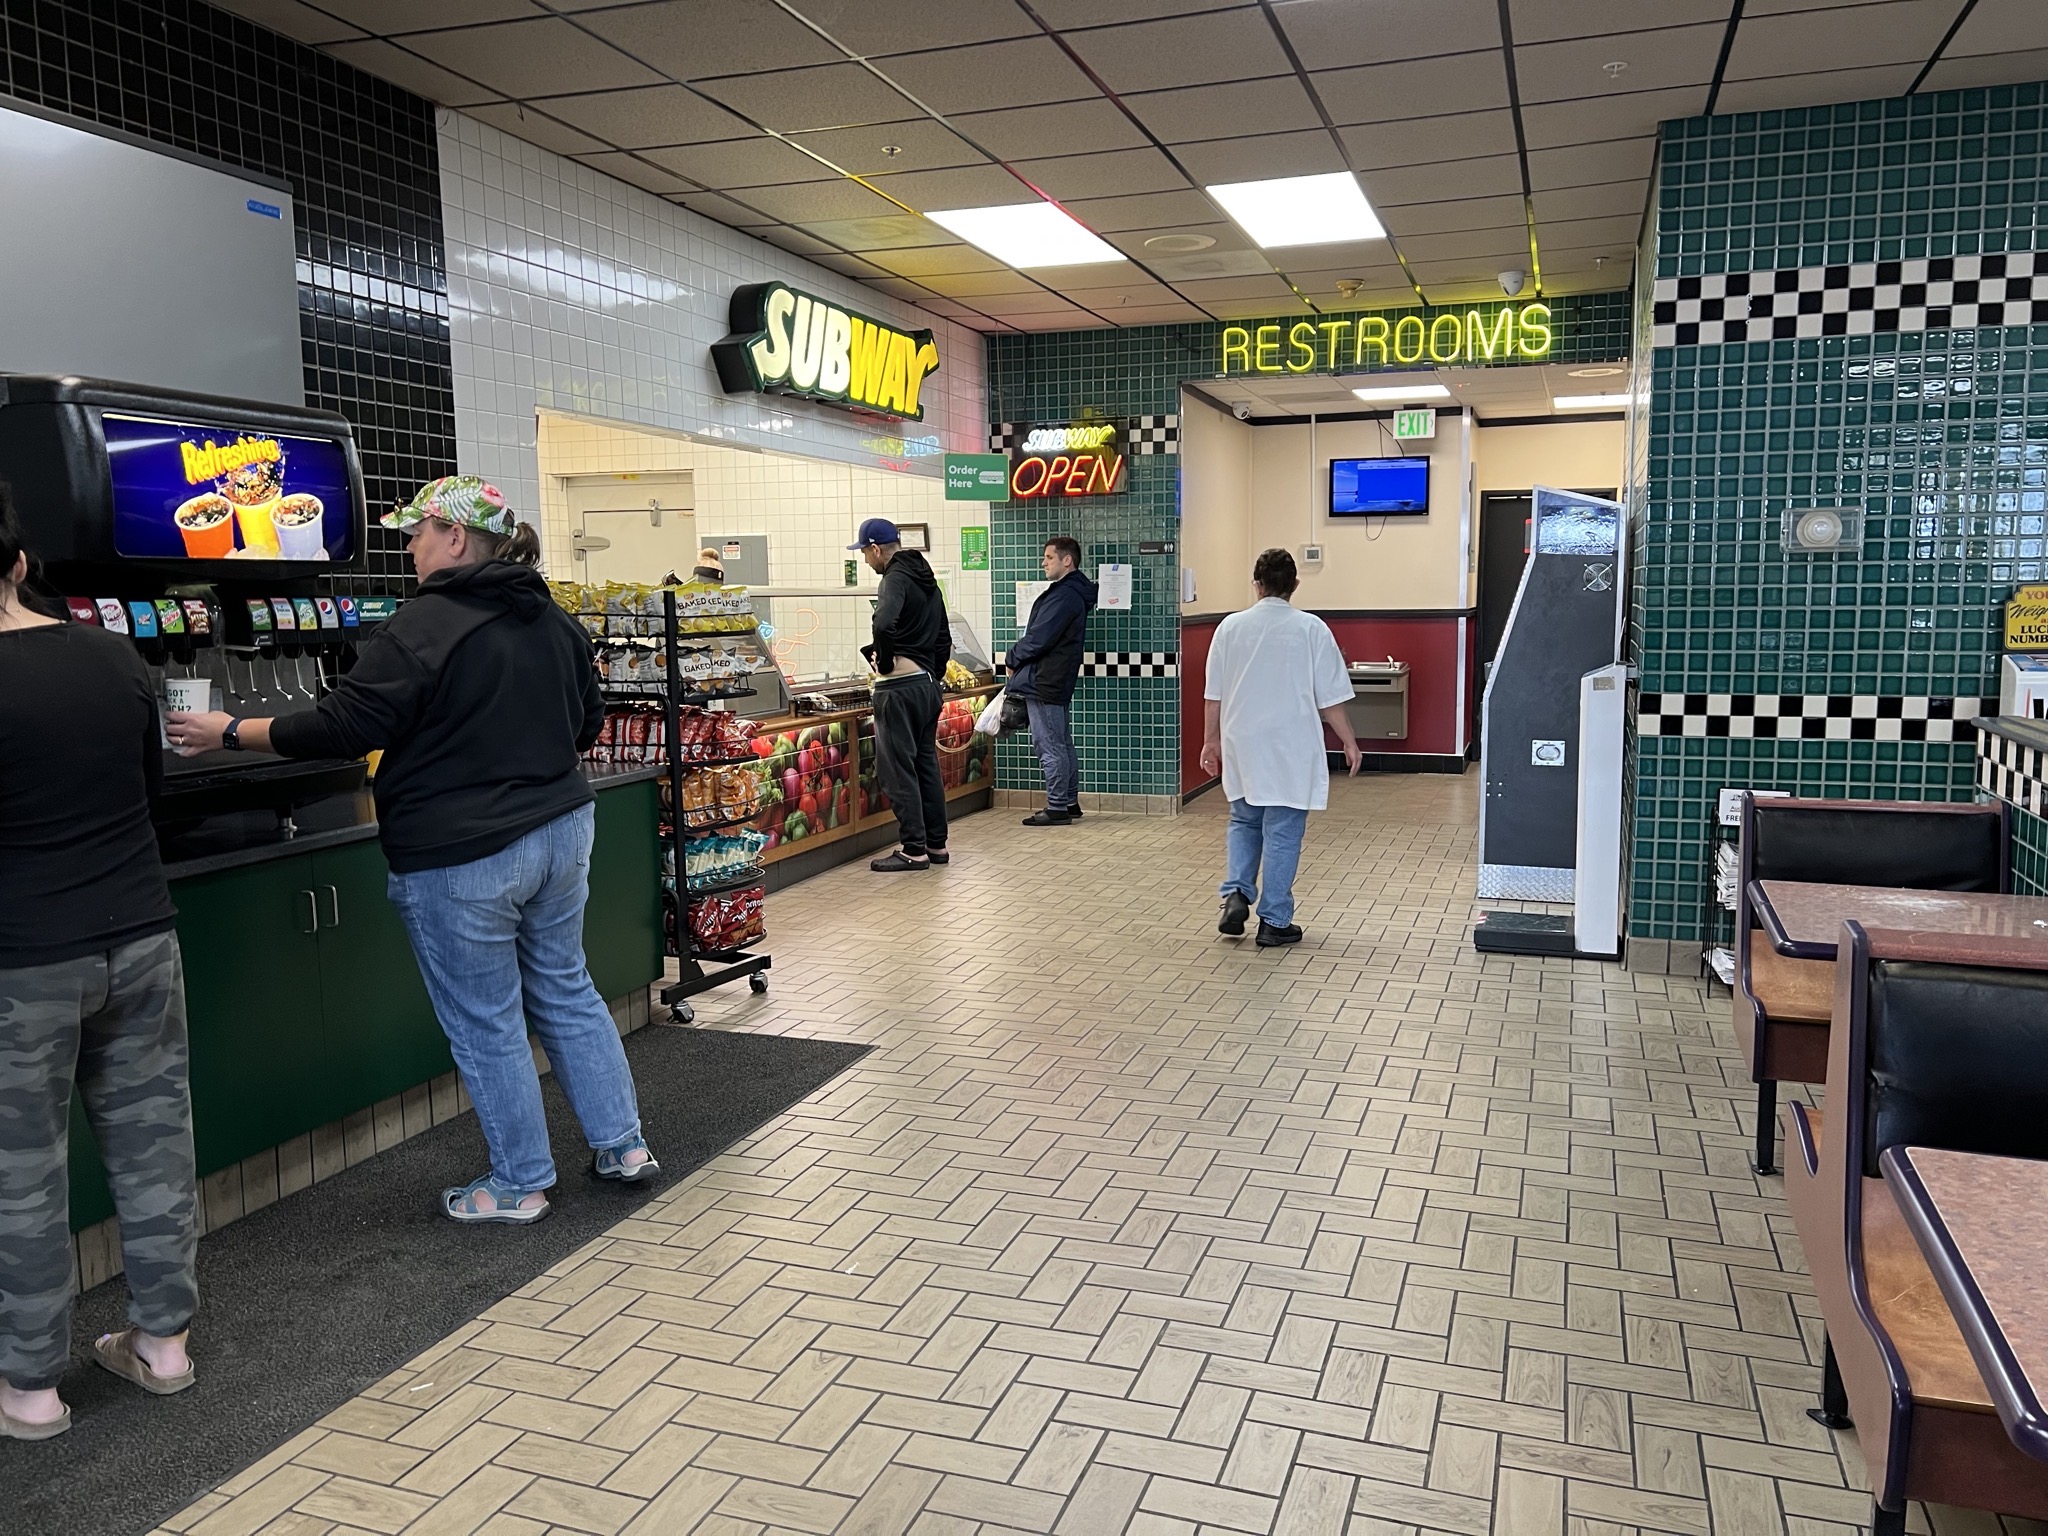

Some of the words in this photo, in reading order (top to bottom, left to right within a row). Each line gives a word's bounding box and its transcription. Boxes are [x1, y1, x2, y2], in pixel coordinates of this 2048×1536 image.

[751, 288, 939, 416] SUBWAY
[1222, 303, 1552, 375] RESTROOMS
[1398, 411, 1431, 437] EXIT
[1022, 425, 1116, 452] SUBWAY
[180, 436, 281, 485] Refreshing
[948, 465, 978, 475] Order
[948, 478, 973, 488] Here
[1012, 454, 1123, 497] OPEN
[677, 597, 706, 610] BAKED
[2020, 625, 2048, 634] LUC
